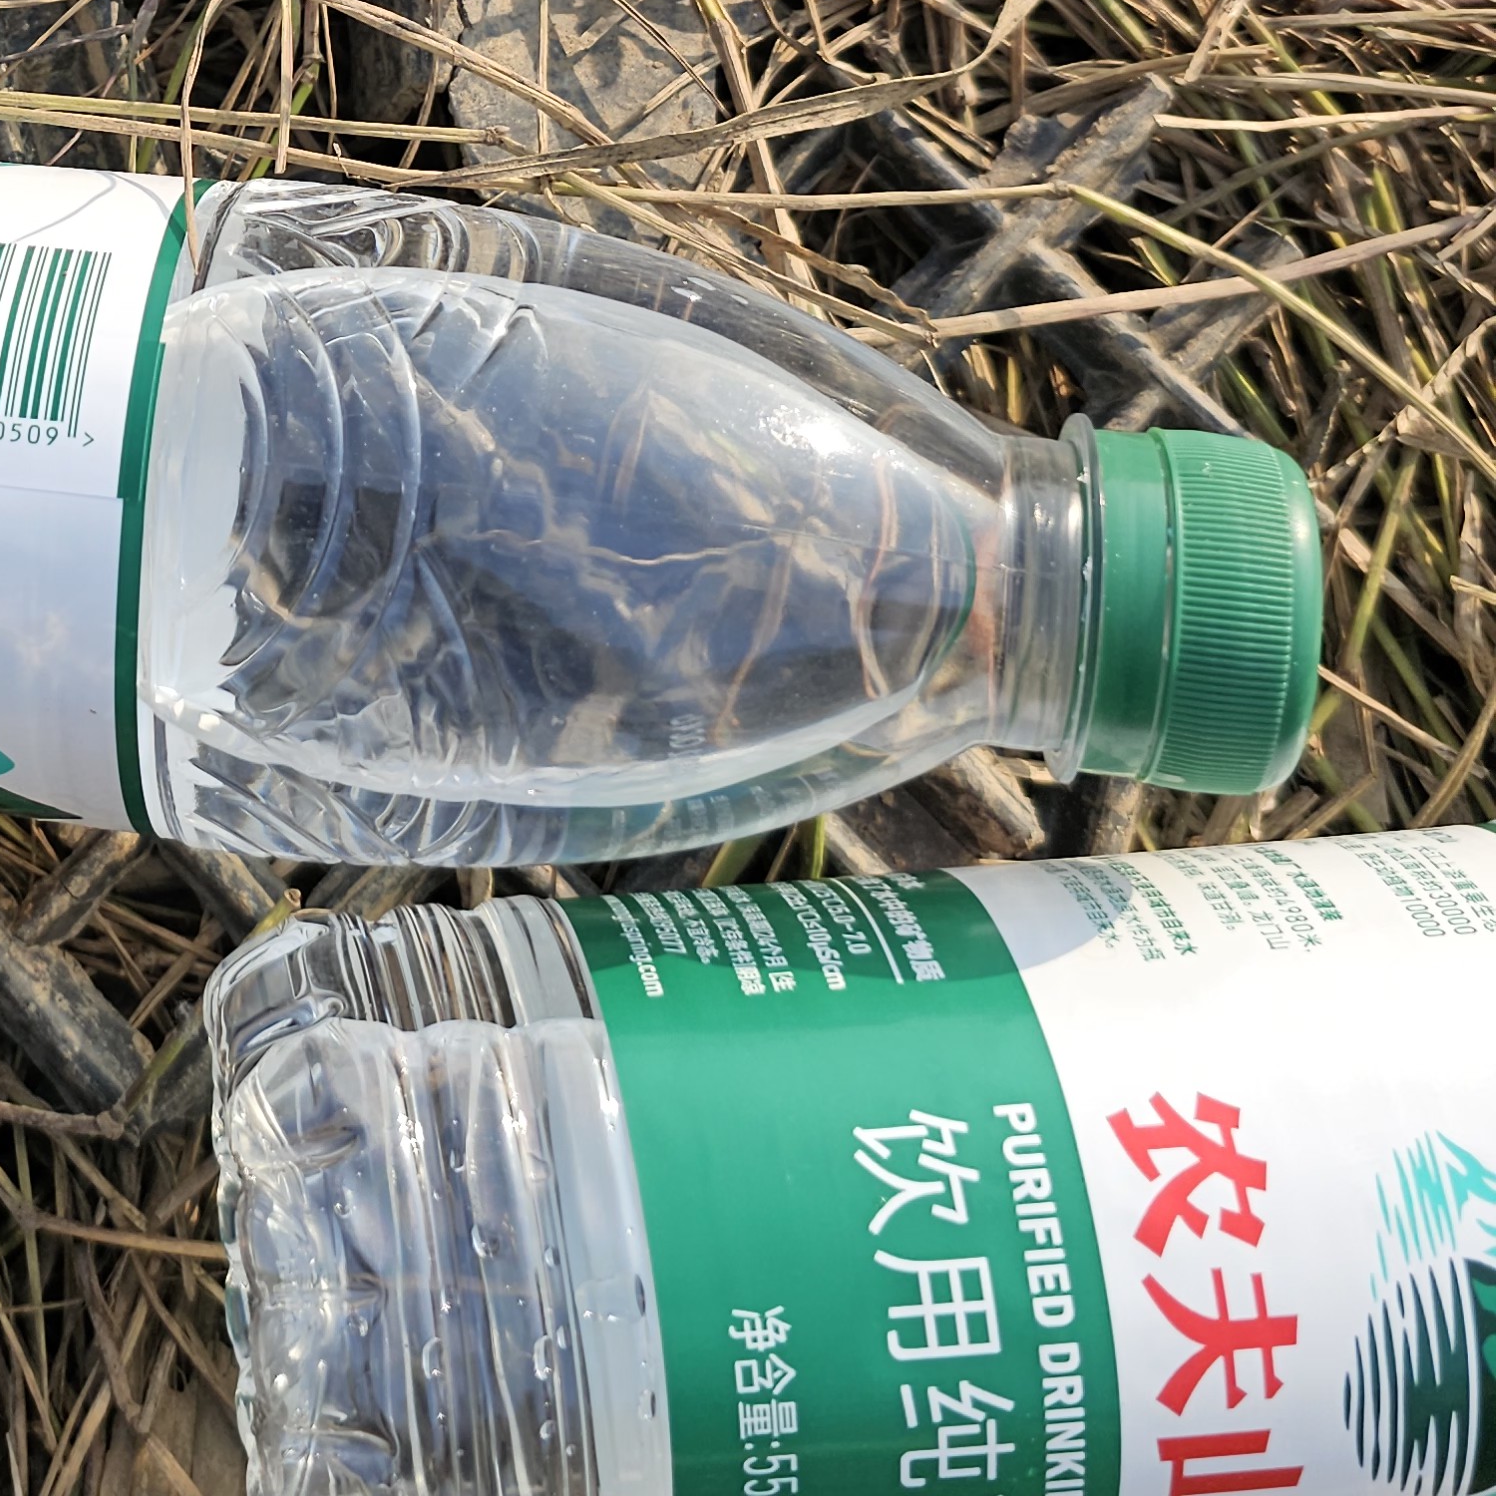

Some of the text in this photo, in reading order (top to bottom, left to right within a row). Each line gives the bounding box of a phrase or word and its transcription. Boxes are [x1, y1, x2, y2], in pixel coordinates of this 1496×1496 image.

[851, 1108, 1016, 1489] 饮用纯
[993, 1102, 1086, 1496] PURIFIED DRINKI
